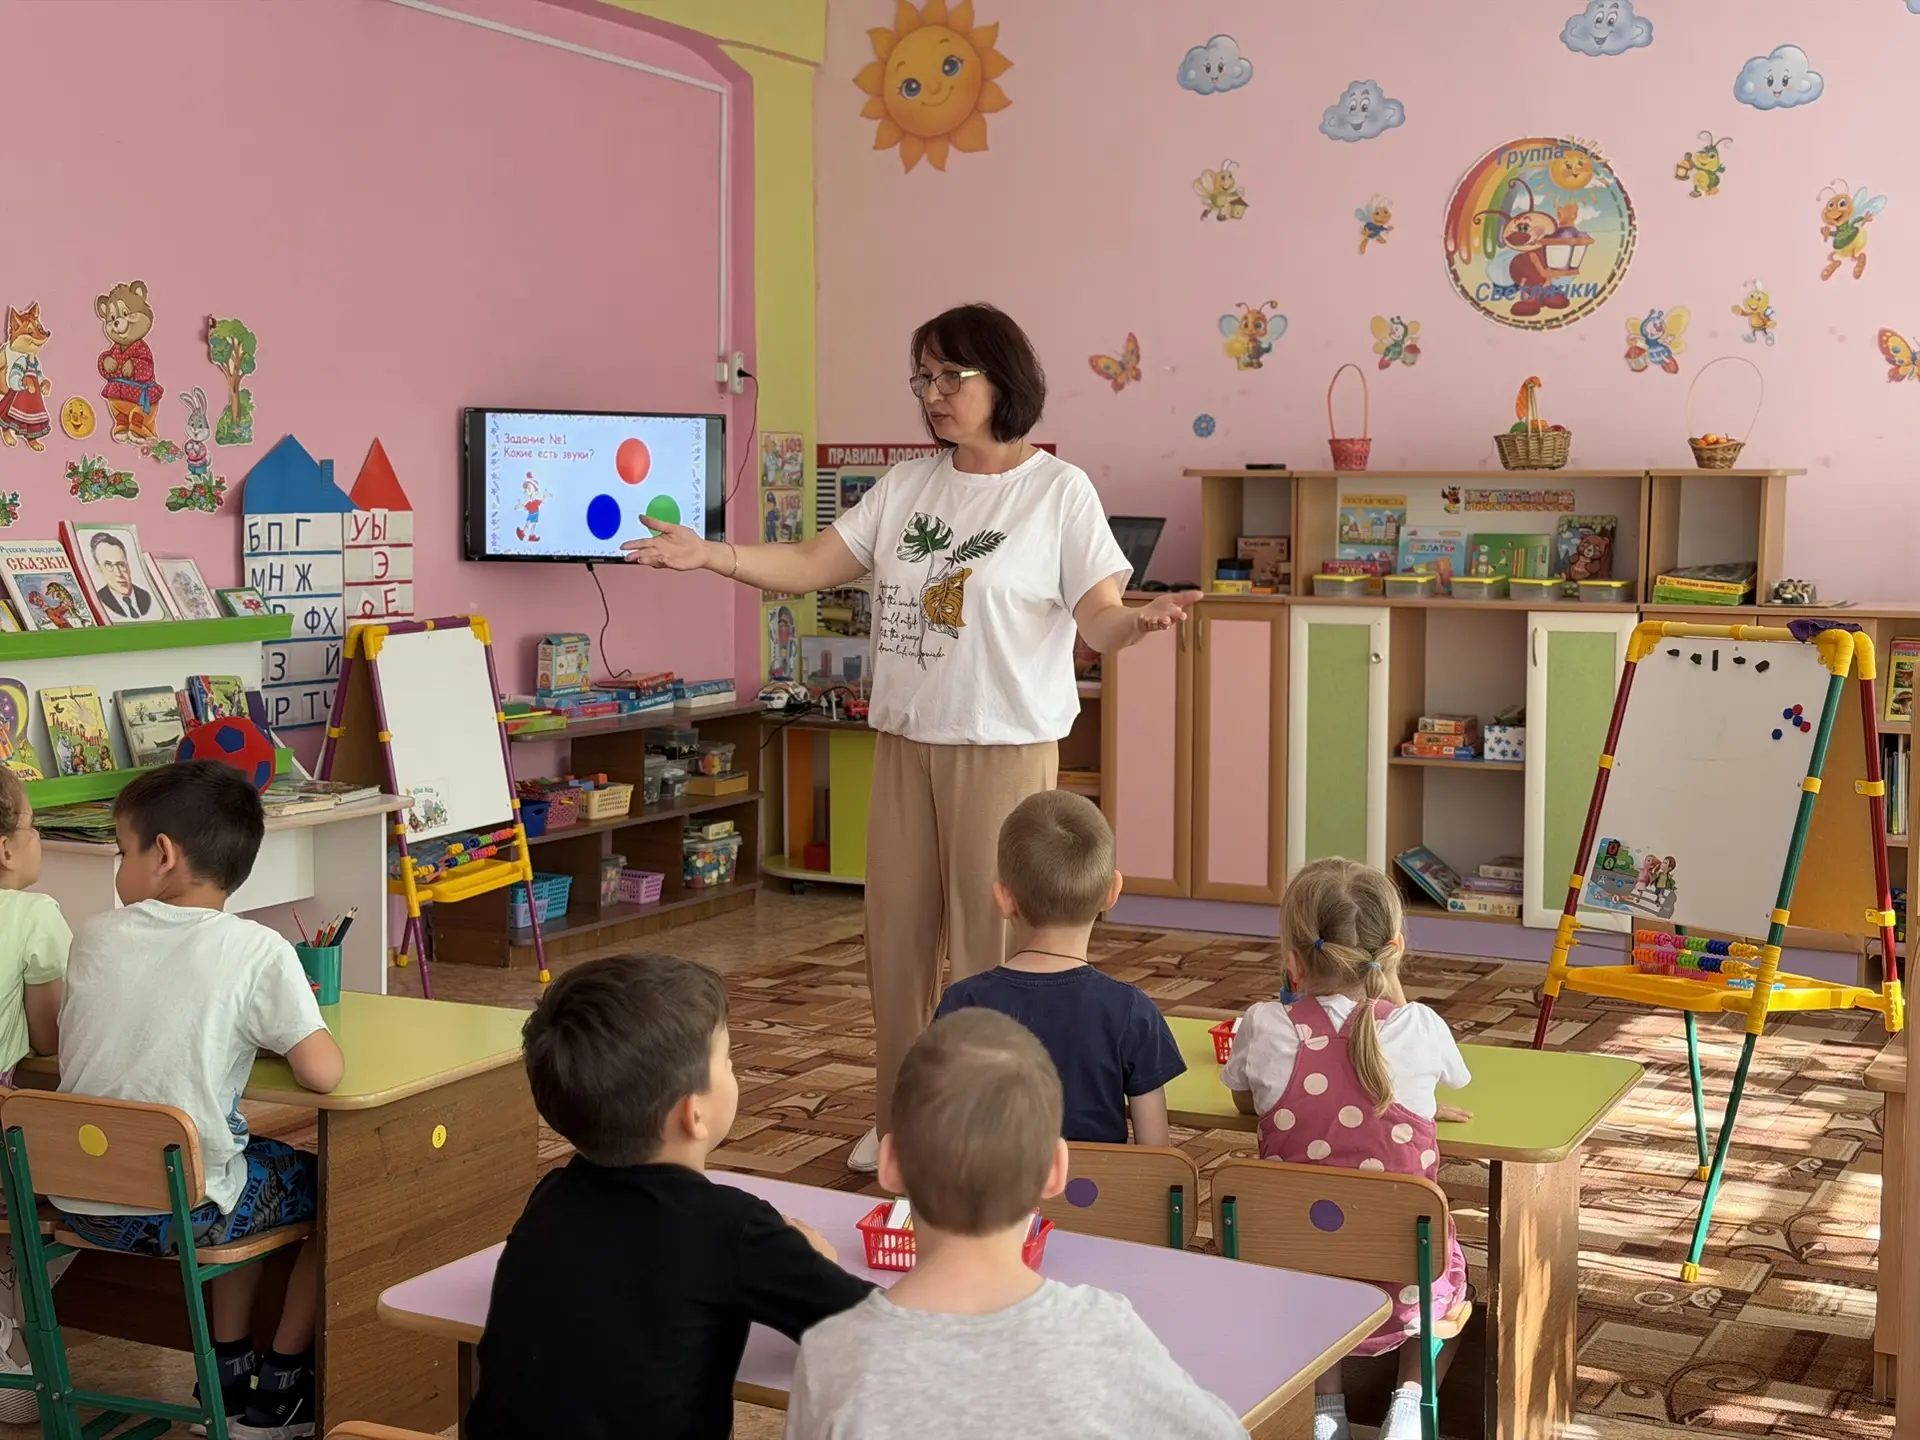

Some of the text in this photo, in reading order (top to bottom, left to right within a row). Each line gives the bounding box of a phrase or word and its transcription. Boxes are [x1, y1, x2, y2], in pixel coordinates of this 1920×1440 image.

[1497, 145, 1565, 169] Группа
[1475, 282, 1599, 302] Светлячки
[504, 432, 567, 445] Задание №1
[503, 446, 595, 462] Какие есть звуки?
[827, 447, 885, 465] ПРАВИЛА
[6, 556, 69, 571] СКАЗКИ
